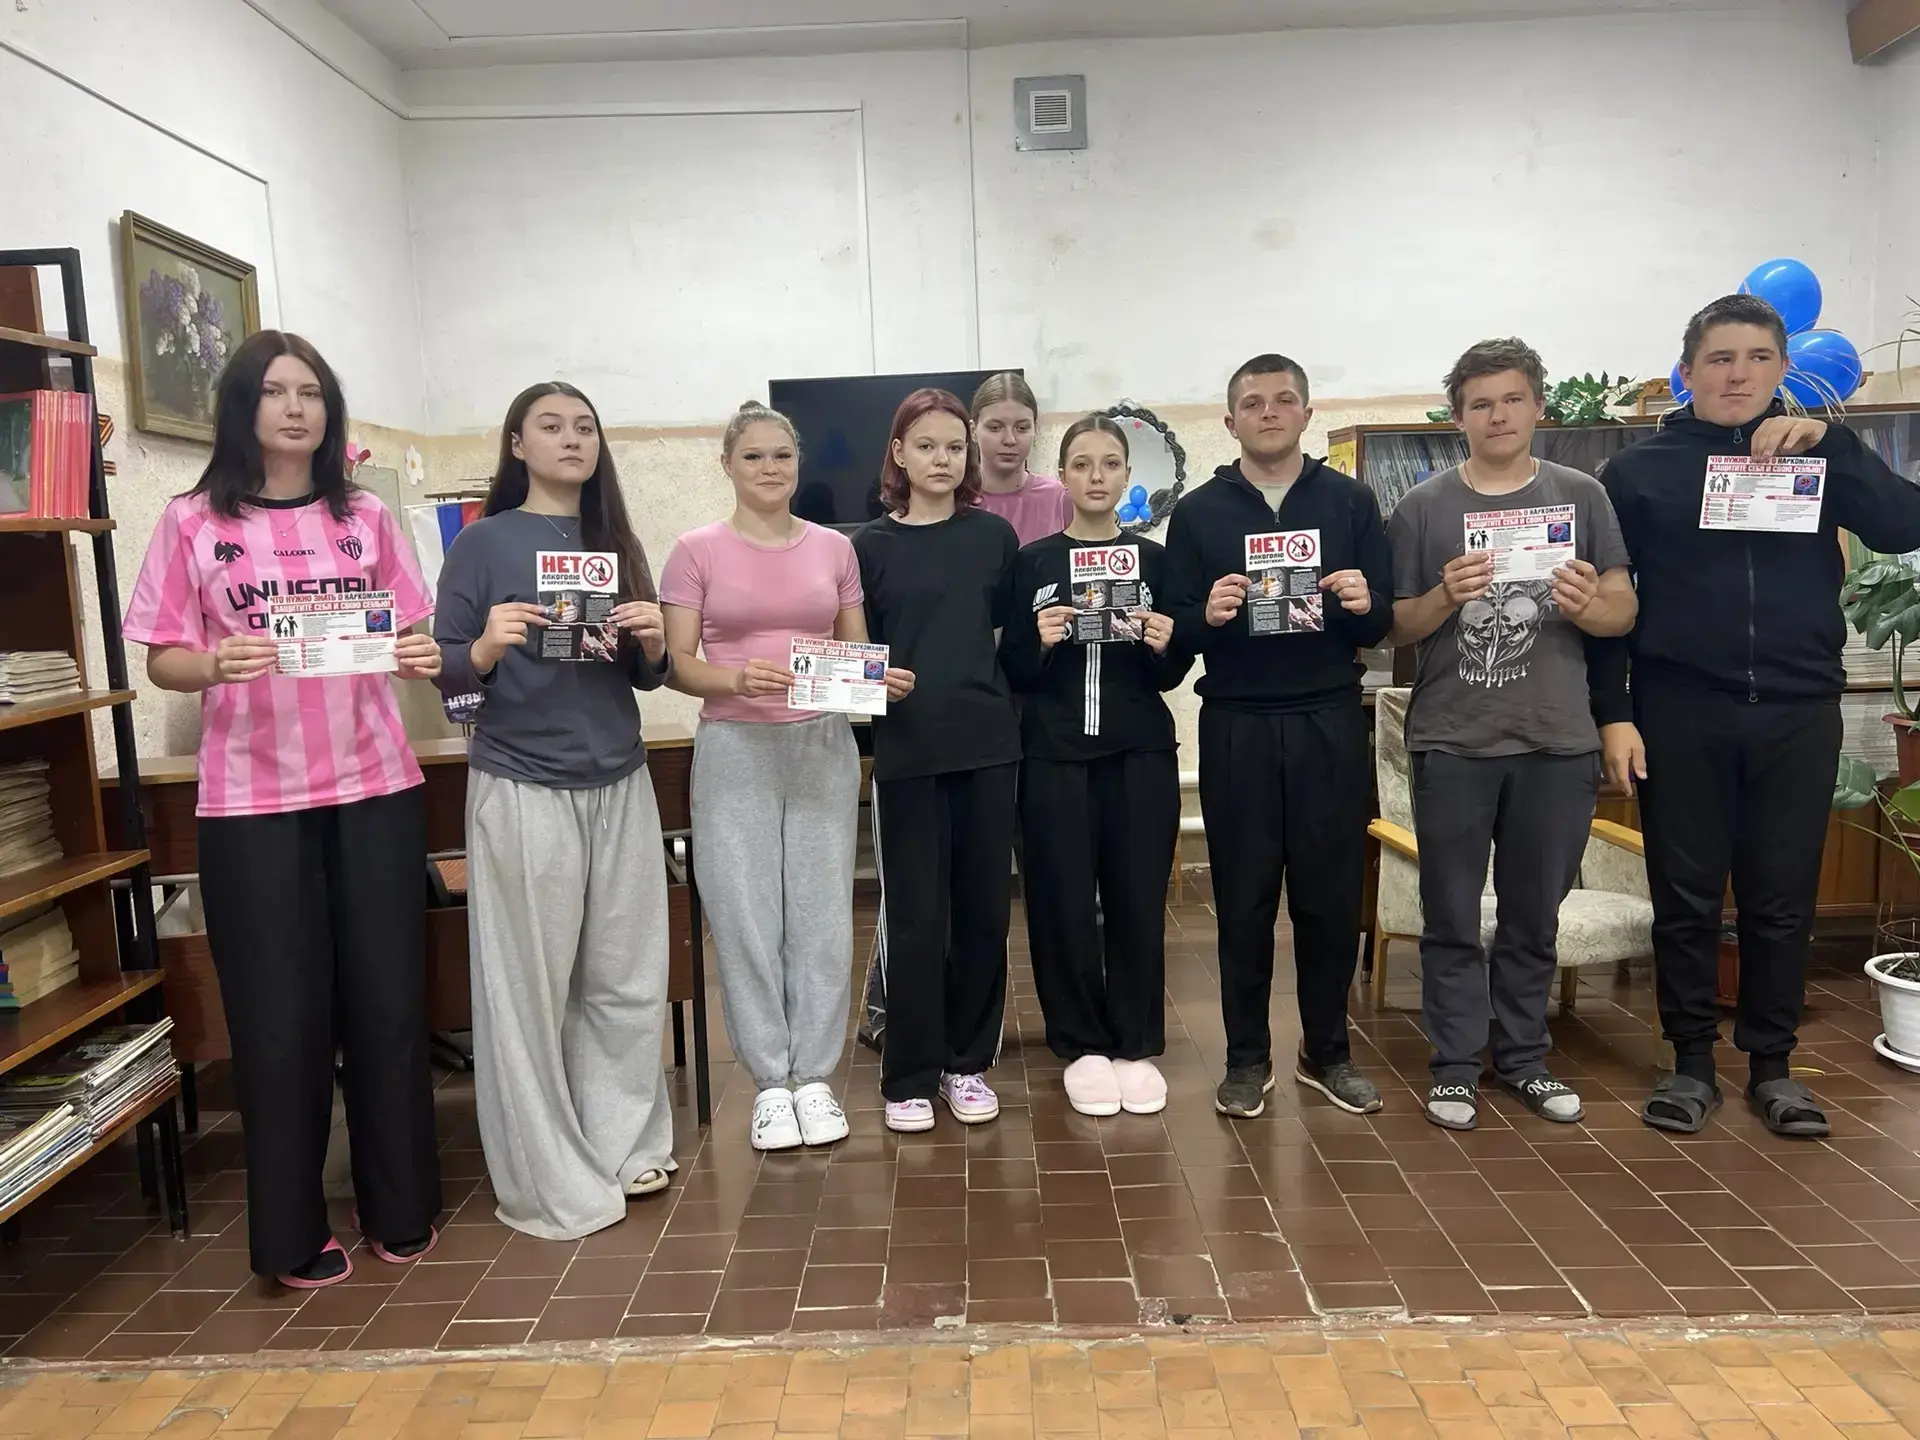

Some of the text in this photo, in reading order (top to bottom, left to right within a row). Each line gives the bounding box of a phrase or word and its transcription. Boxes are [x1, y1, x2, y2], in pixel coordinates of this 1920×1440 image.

[1503, 510, 1522, 518] ЗНАТЬ
[1250, 536, 1286, 554] НЕТ
[542, 555, 582, 573] НЕТ
[1074, 550, 1108, 567] НЕТ
[270, 596, 284, 604] ЧТО
[286, 595, 312, 603] НУЖНО
